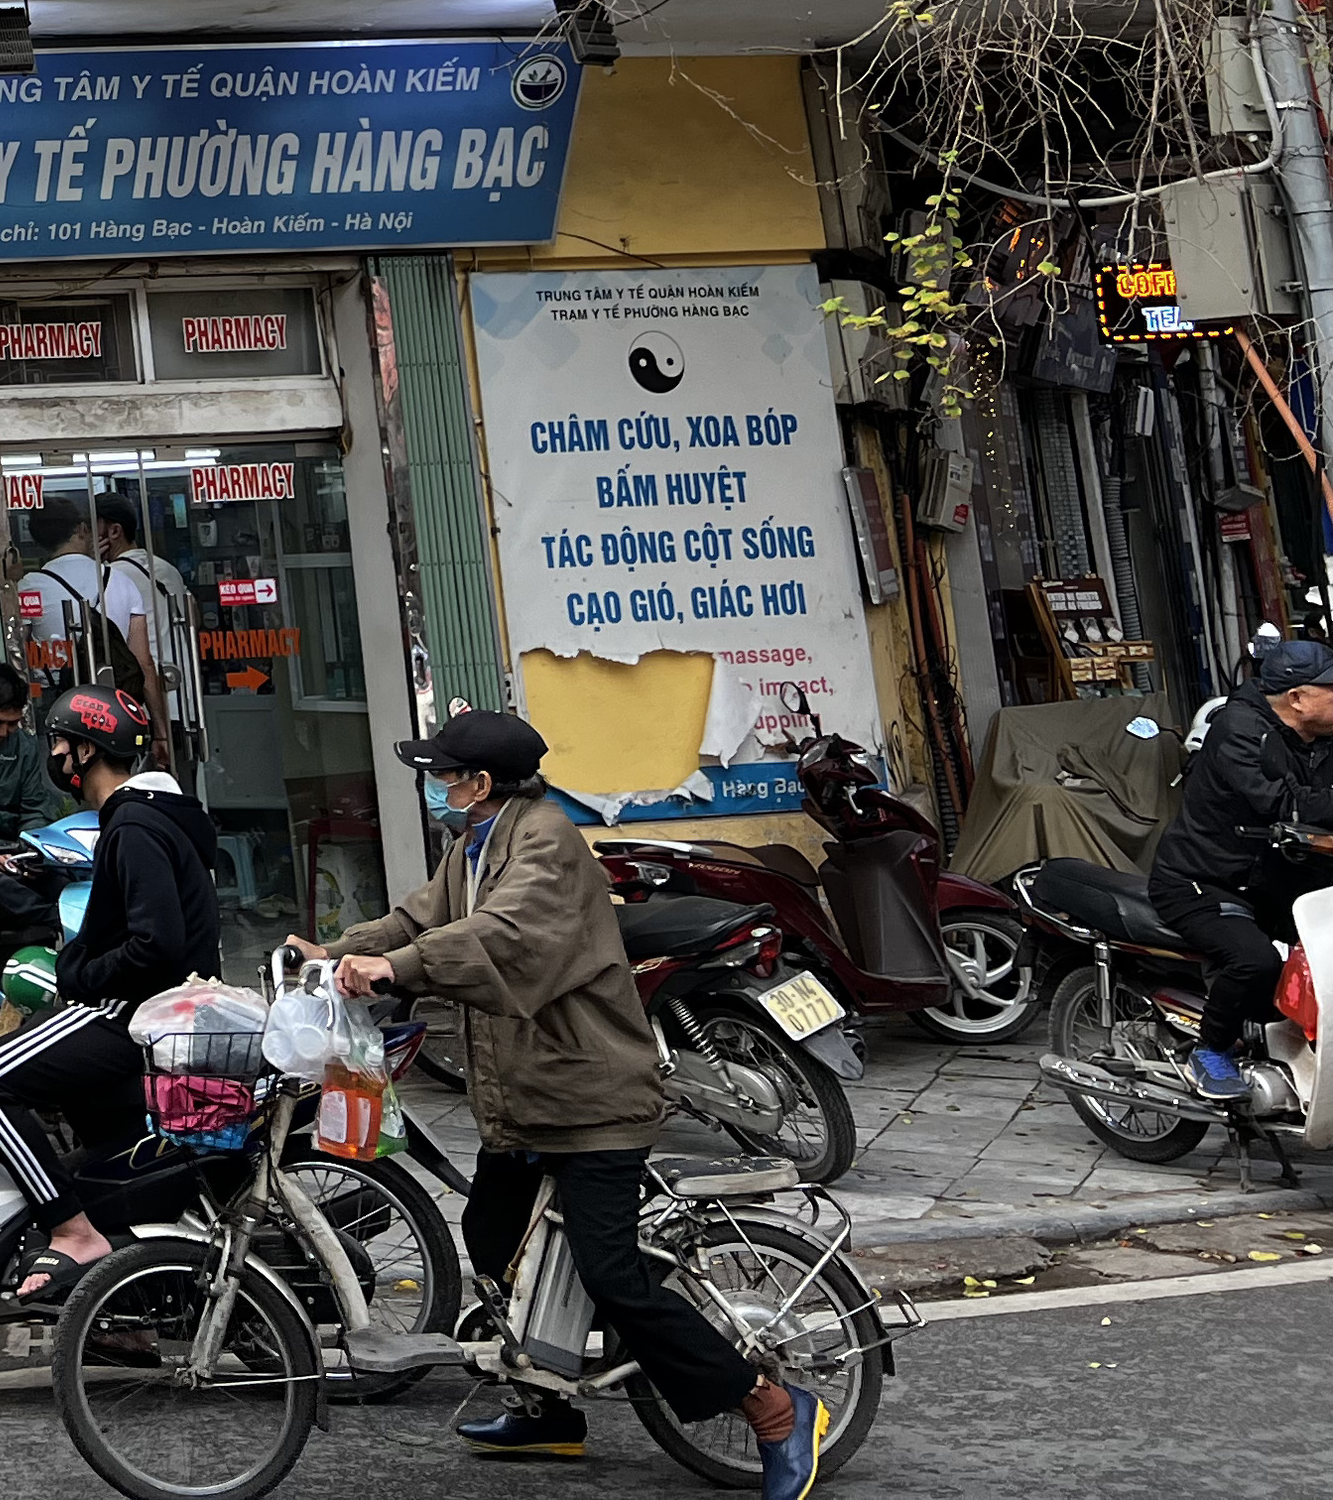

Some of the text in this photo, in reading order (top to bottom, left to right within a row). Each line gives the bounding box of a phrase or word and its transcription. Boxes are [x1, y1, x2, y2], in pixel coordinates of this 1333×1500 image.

[54, 70, 120, 102] TÂM
[131, 75, 152, 100] Y
[161, 64, 205, 98] TẾ
[210, 66, 298, 102] QUẬN
[307, 63, 396, 95] HOÀN
[405, 57, 481, 93] KIẾM
[33, 118, 97, 203] TẾ
[99, 118, 300, 201] PHƯỜNG
[310, 117, 443, 194] HÀNG
[453, 124, 549, 202] BẠC
[0, 221, 39, 242] chỉ:
[48, 222, 80, 240] 101
[91, 220, 145, 242] Hàng
[152, 217, 192, 240] Bạc
[212, 216, 265, 235] Hoàn
[273, 211, 325, 232] Kiếm
[344, 212, 372, 230] Hà
[378, 211, 413, 232] Nội
[536, 282, 760, 302] TRUNG TÂM Y TẾ QUẬN HOÀN KIẾM
[551, 303, 750, 323] TRẠM Y TẾ PHƯỜNG HÀNG BẠC
[183, 314, 288, 353] PHARMACY
[531, 407, 798, 454] CHÂM CỨU, XOA BÓP
[191, 463, 295, 503] PHARMACY
[596, 463, 747, 511] BẤM HUYỆT
[541, 515, 816, 572] TÁC ĐỘNG CỘT SỐNG
[567, 578, 808, 632] CẠO GIÓ, GIÁC HƠI
[199, 628, 301, 661] PHARMACY
[718, 647, 813, 667] massage,
[787, 997, 834, 1033] 0777
